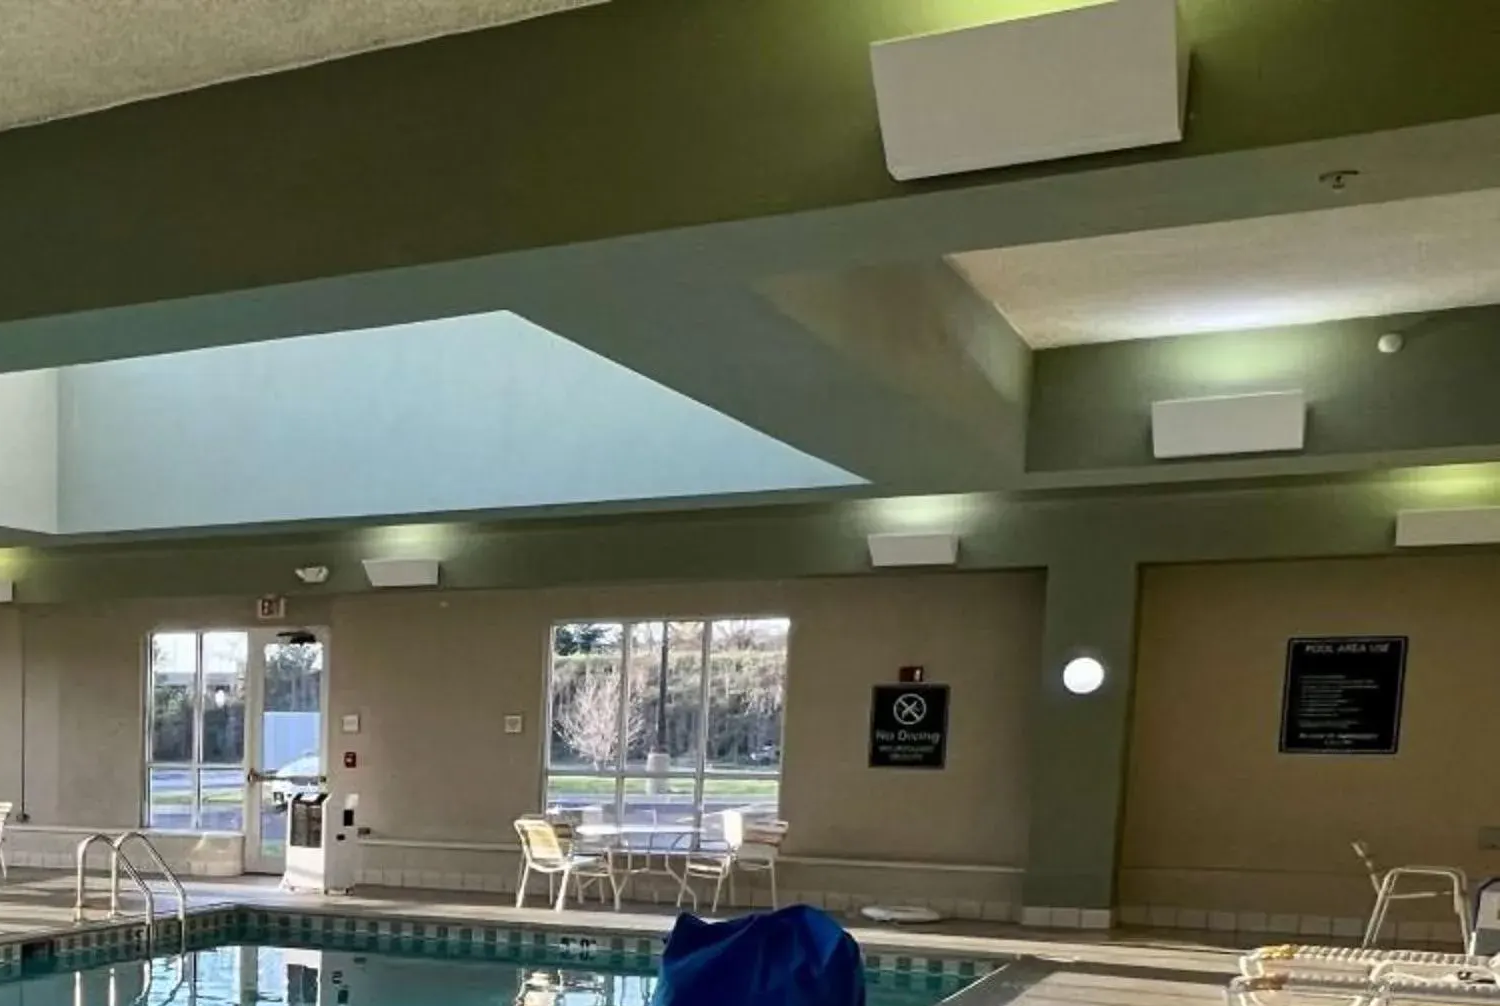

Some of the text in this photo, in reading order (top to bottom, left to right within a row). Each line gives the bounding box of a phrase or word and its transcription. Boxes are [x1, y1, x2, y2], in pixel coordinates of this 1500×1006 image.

[1337, 643, 1366, 654] AREA
[877, 728, 941, 745] No Diving
